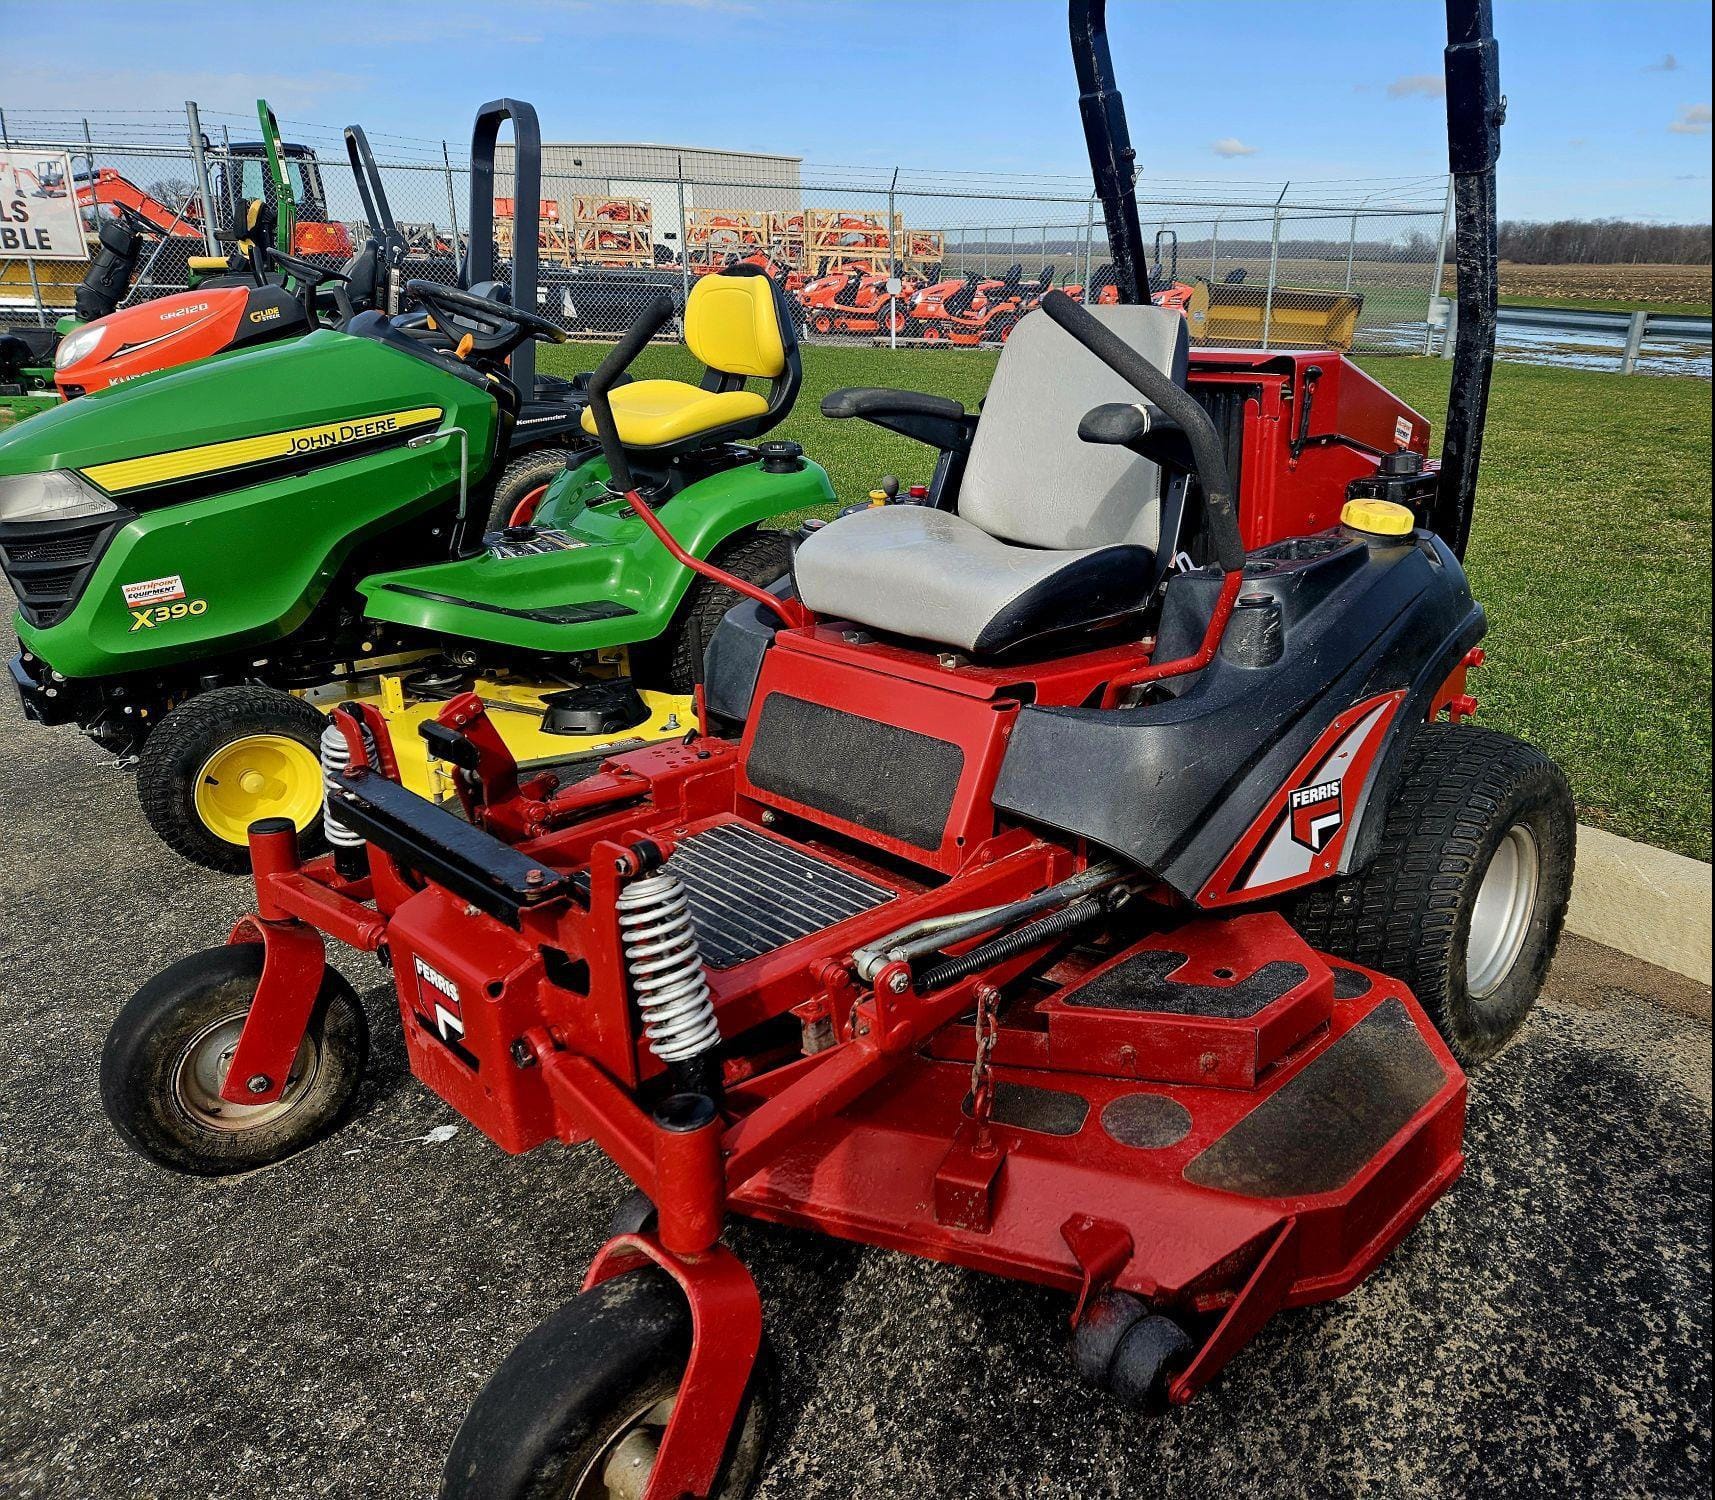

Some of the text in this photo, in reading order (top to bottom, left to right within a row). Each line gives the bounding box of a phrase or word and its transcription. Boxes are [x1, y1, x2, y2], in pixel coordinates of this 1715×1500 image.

[0, 227, 52, 250] BLE
[160, 303, 208, 320] GR2120
[250, 306, 280, 323] GLIDE
[516, 414, 568, 426] Kommander
[286, 418, 397, 454] JOHN DEERE
[128, 586, 176, 599] EQUIPMENT
[129, 599, 208, 632] X390
[1292, 781, 1340, 808] FERRIS
[415, 957, 460, 1002] FERRIS
